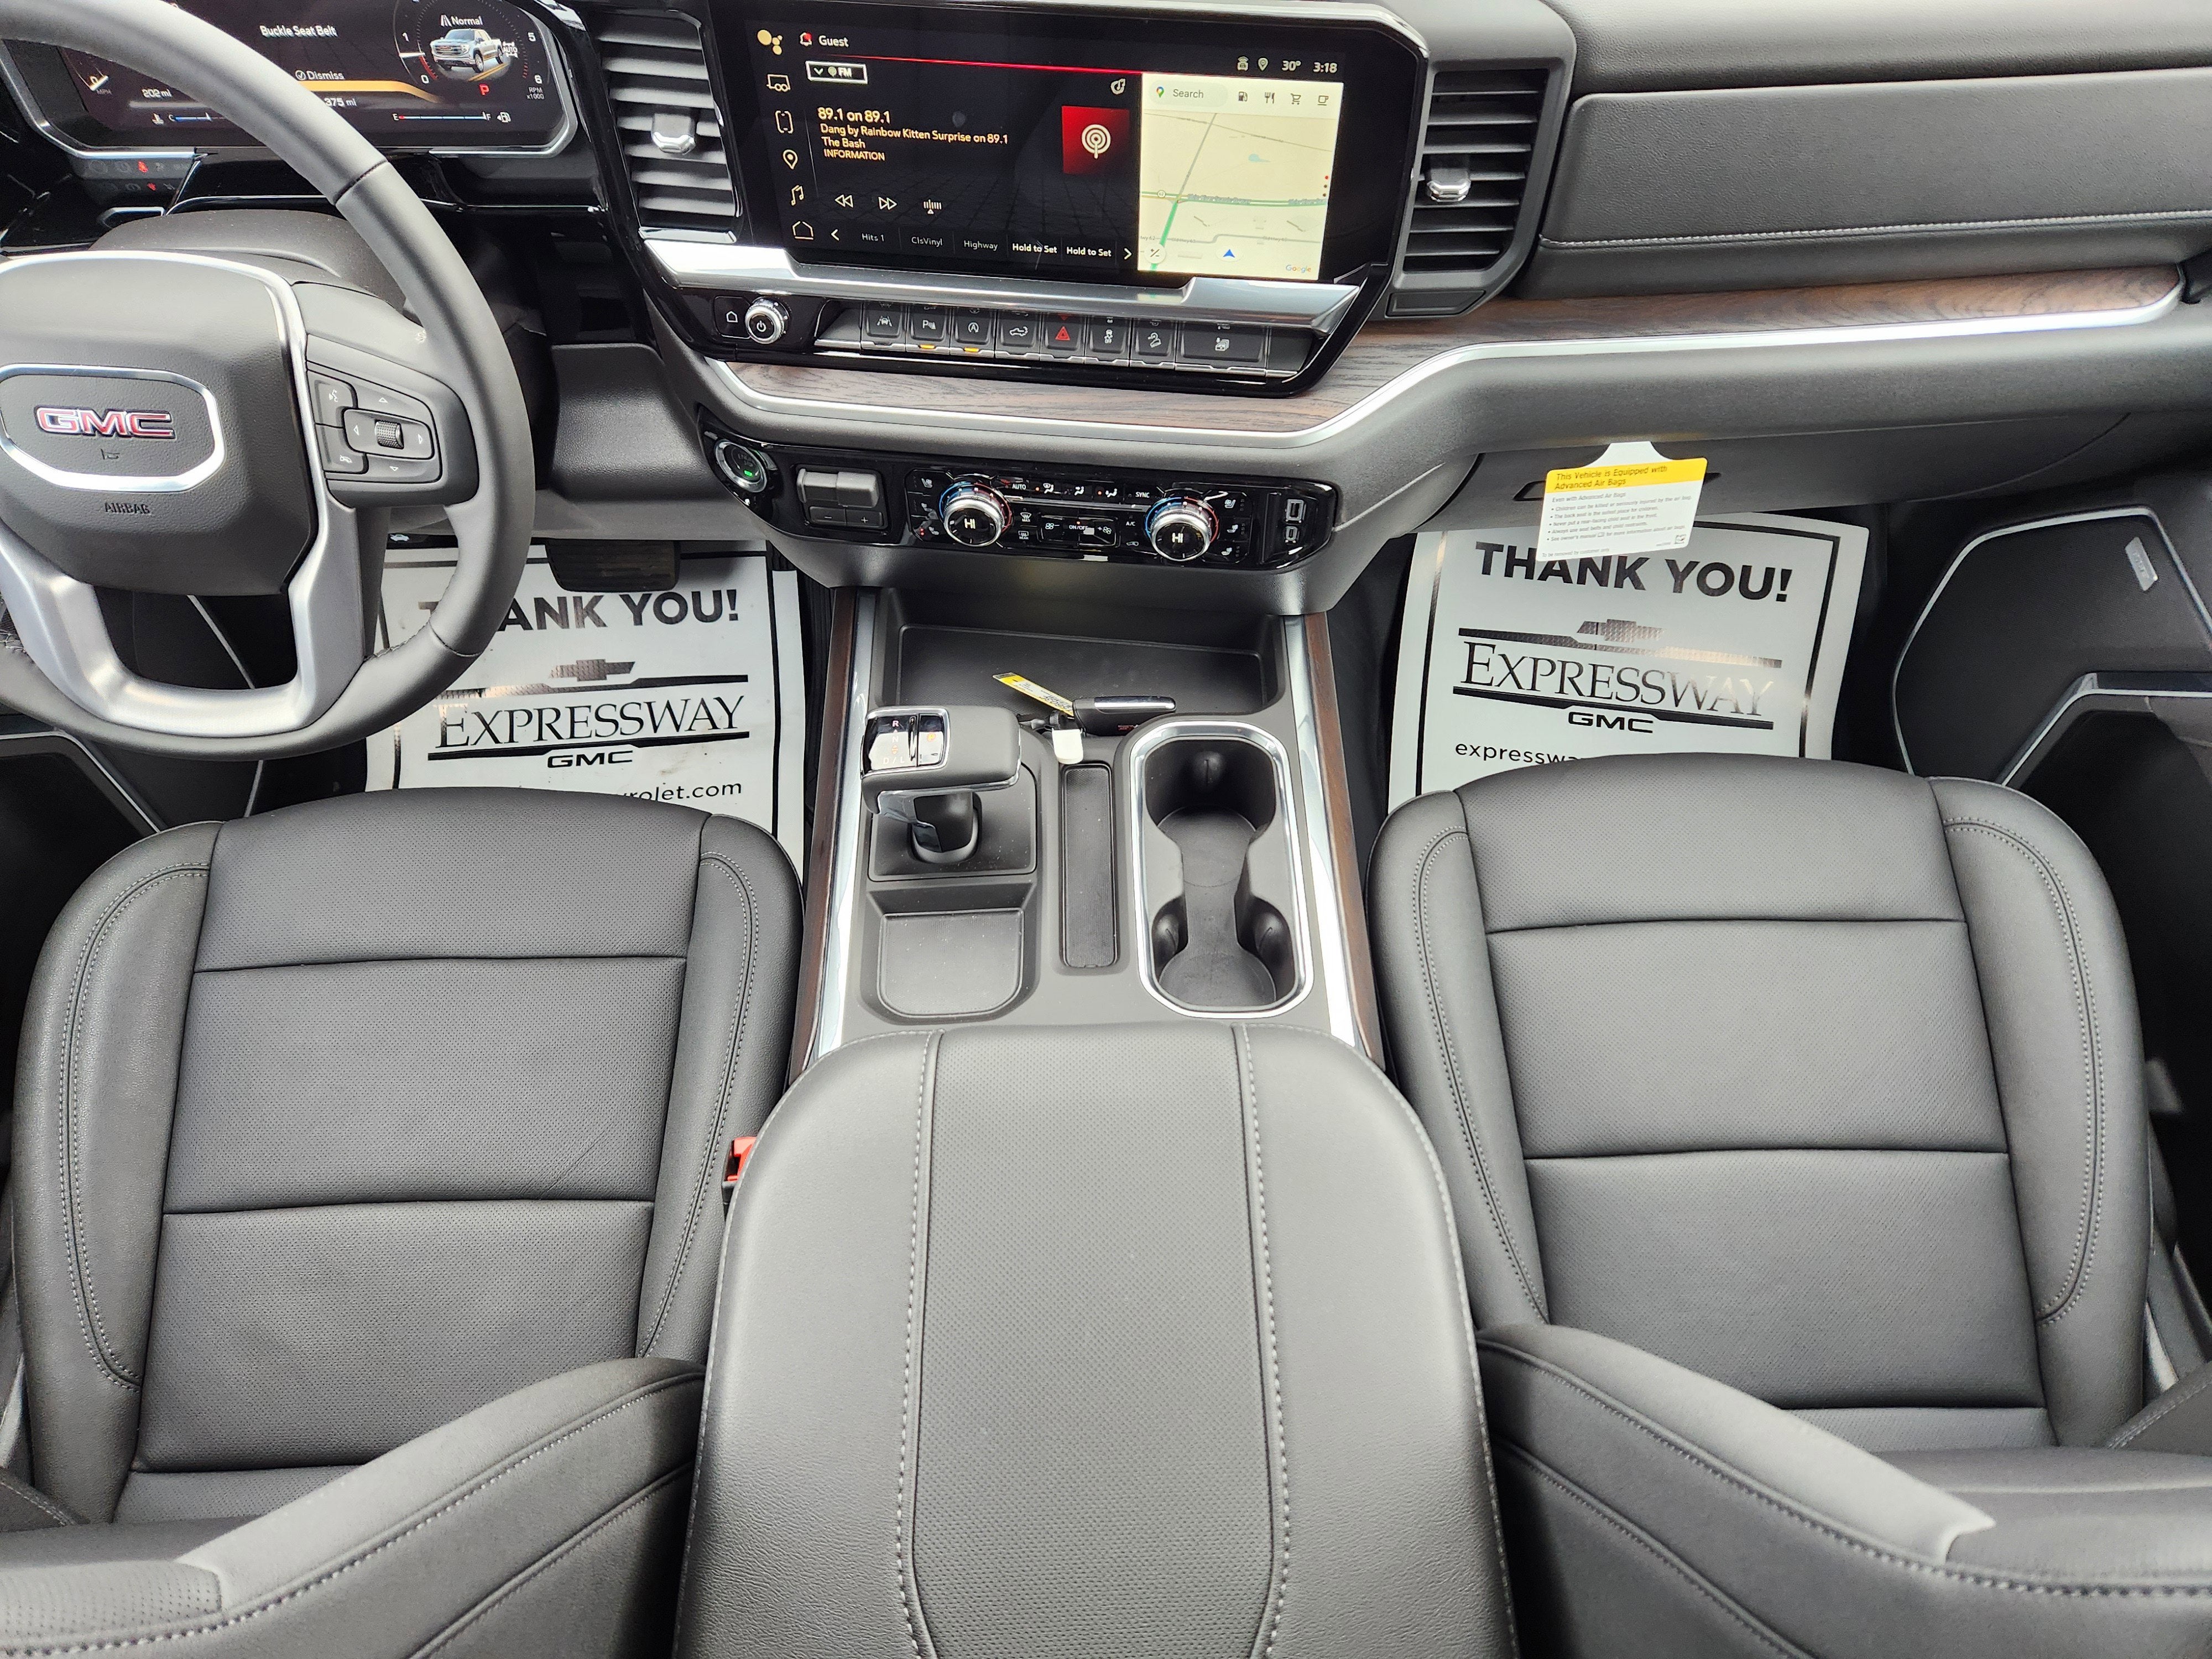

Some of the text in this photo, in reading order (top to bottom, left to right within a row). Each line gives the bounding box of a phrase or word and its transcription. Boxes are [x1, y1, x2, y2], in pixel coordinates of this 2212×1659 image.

[451, 15, 483, 26] Normal
[259, 25, 338, 38] Buckle Seat Belt
[402, 32, 410, 42] 1
[528, 32, 536, 42] 5
[818, 35, 849, 48] Guest
[838, 67, 852, 77] FM
[1313, 62, 1338, 74] 3:18
[306, 70, 345, 80] Dismiss
[421, 74, 429, 84] 0
[534, 74, 542, 84] 6
[479, 84, 490, 95] P
[1172, 88, 1204, 98] Search
[817, 107, 890, 124] 89.1 on 89.1
[820, 123, 1008, 144] Dang by Rainbow Kitten Surprise on 89.1
[821, 136, 865, 149] The Bash
[823, 148, 885, 161] INFORMATION
[862, 233, 878, 242] Hits
[911, 236, 943, 247] ClsVinyl
[964, 240, 998, 251] Highway
[1013, 243, 1031, 252] Hold
[1044, 246, 1057, 254] Set
[1067, 247, 1112, 257] Hold to Set
[1286, 264, 1311, 273] Google
[34, 405, 177, 439] GMC
[1575, 471, 1602, 479] Vehicle
[1613, 467, 1649, 476] Equipped
[1555, 481, 1592, 490] Advanced
[104, 502, 150, 515] AIRBAG
[963, 518, 976, 529] HI
[1171, 533, 1183, 544] HI
[1475, 541, 1793, 602] THANK YOU!
[619, 589, 739, 627] YOU!
[1460, 641, 1774, 717] EXPRESSWAY
[434, 695, 744, 749] EXPRESSWAY
[1567, 712, 1653, 734] GMC
[547, 750, 633, 769] GMC
[1455, 743, 1577, 765] expressw
[623, 782, 742, 801] olet.com
